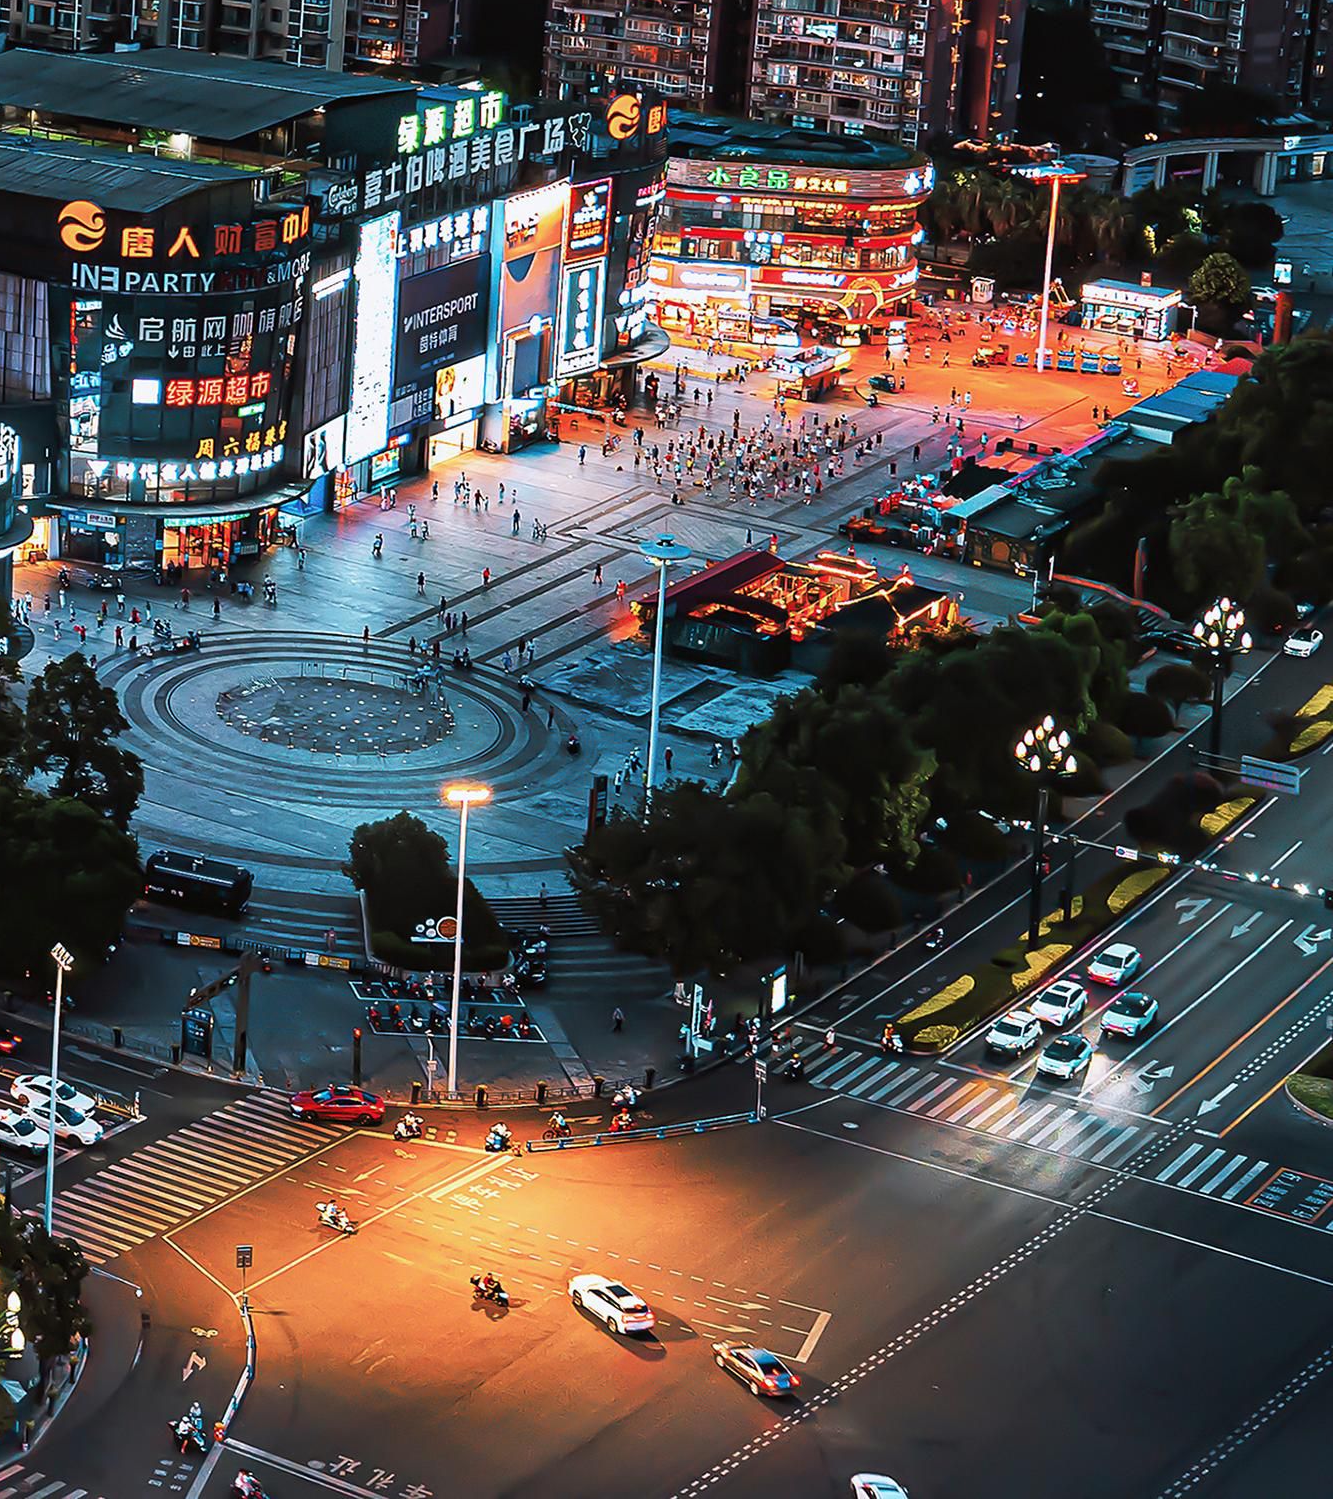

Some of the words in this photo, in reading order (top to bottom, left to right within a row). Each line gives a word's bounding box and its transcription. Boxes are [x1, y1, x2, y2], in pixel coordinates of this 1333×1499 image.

[398, 92, 503, 152] 绿源超市
[364, 118, 564, 209] 嘉士伯啤酒美食广场
[706, 165, 789, 189] 小良品
[125, 272, 215, 292] PARTY
[139, 299, 304, 343] 启航网咖旗舰店
[413, 293, 478, 331] INTERSPORT
[166, 373, 272, 406] 绿源超市
